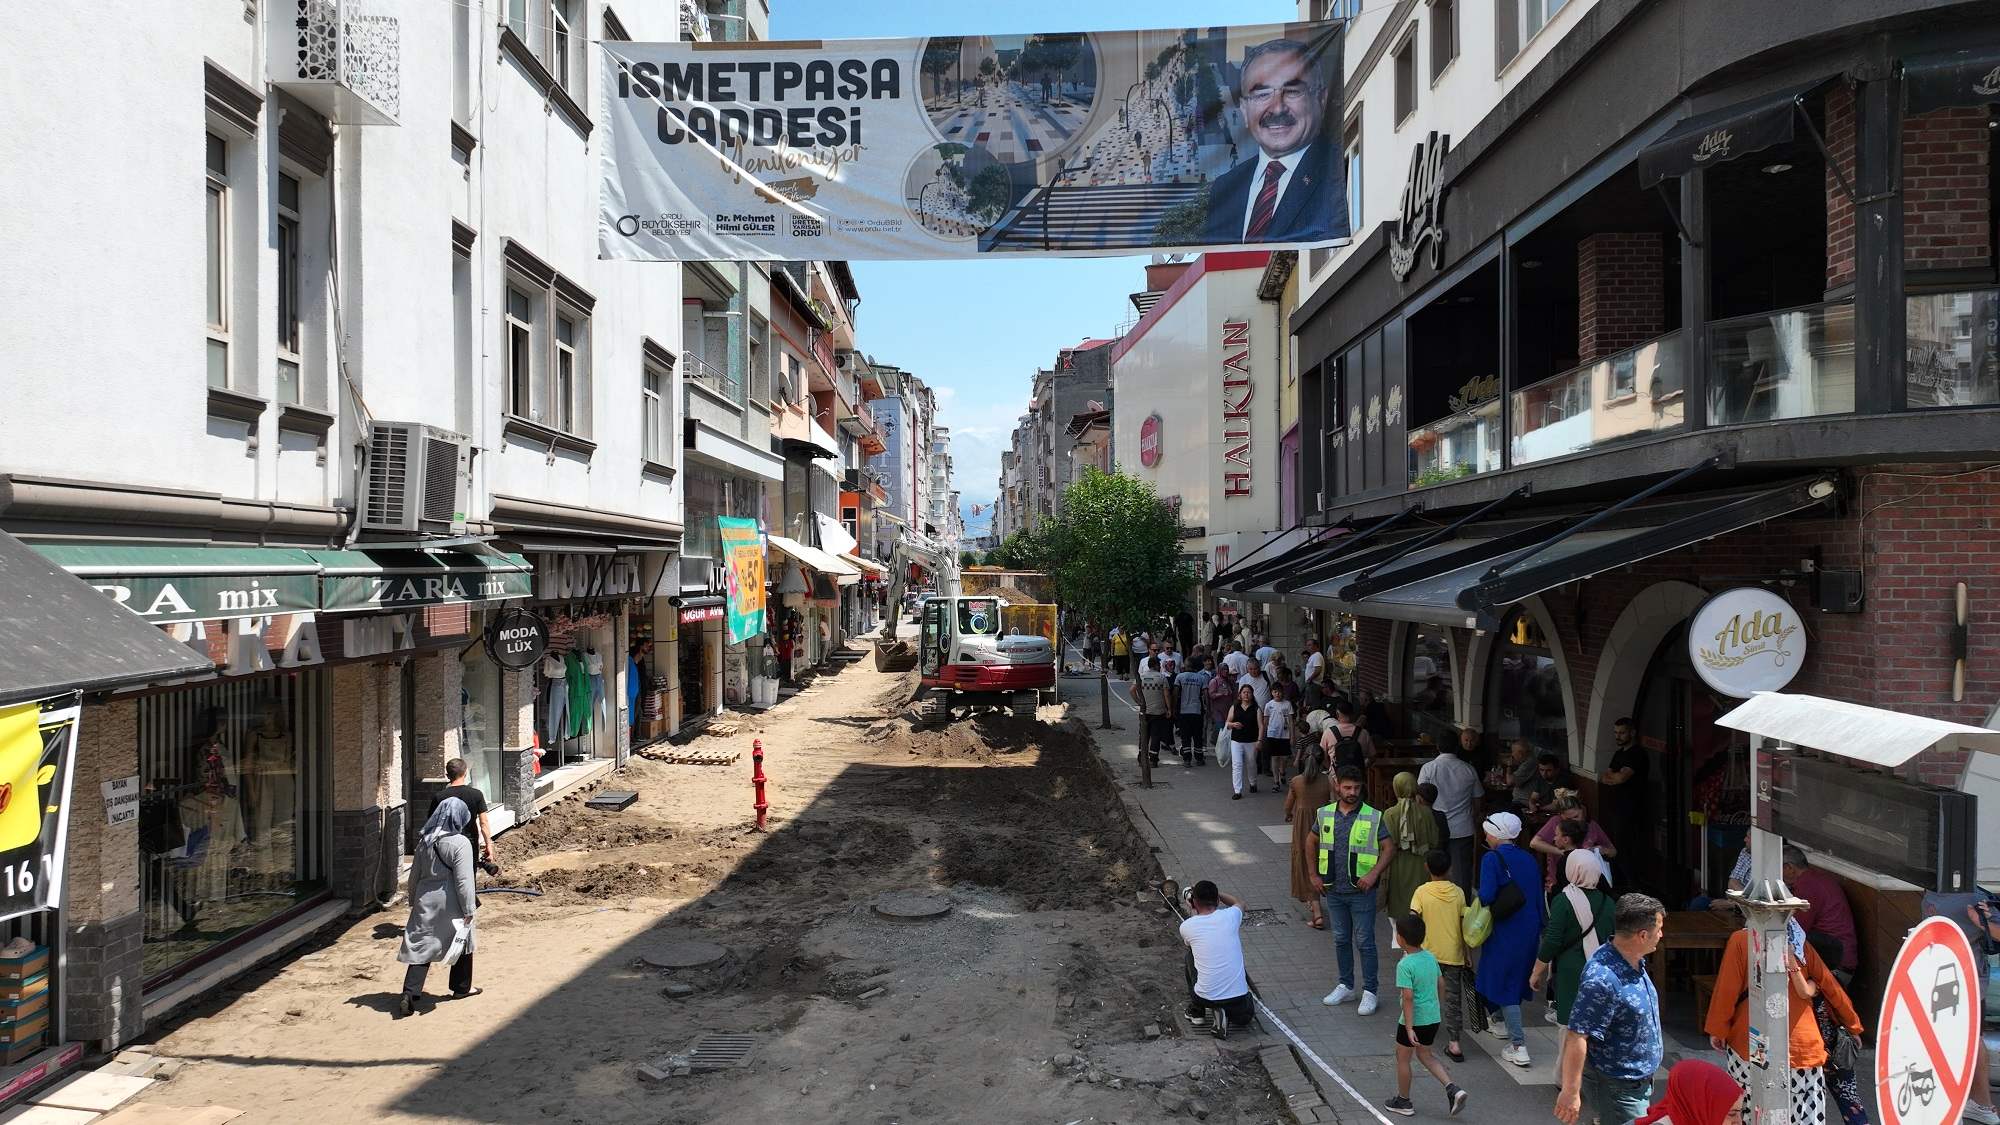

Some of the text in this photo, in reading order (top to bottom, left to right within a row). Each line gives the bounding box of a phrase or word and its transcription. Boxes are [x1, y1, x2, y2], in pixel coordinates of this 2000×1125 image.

[716, 214, 775, 223] Dr. Mehmet
[716, 222, 775, 232] Hilmi GÜLER
[792, 229, 821, 237] ORDU
[1222, 318, 1254, 499] HALKTAN
[217, 580, 279, 611] mix
[367, 574, 506, 604] ZARA mix
[500, 625, 538, 641] MODA
[1714, 609, 1782, 656] Ada
[507, 639, 533, 654] LÜX
